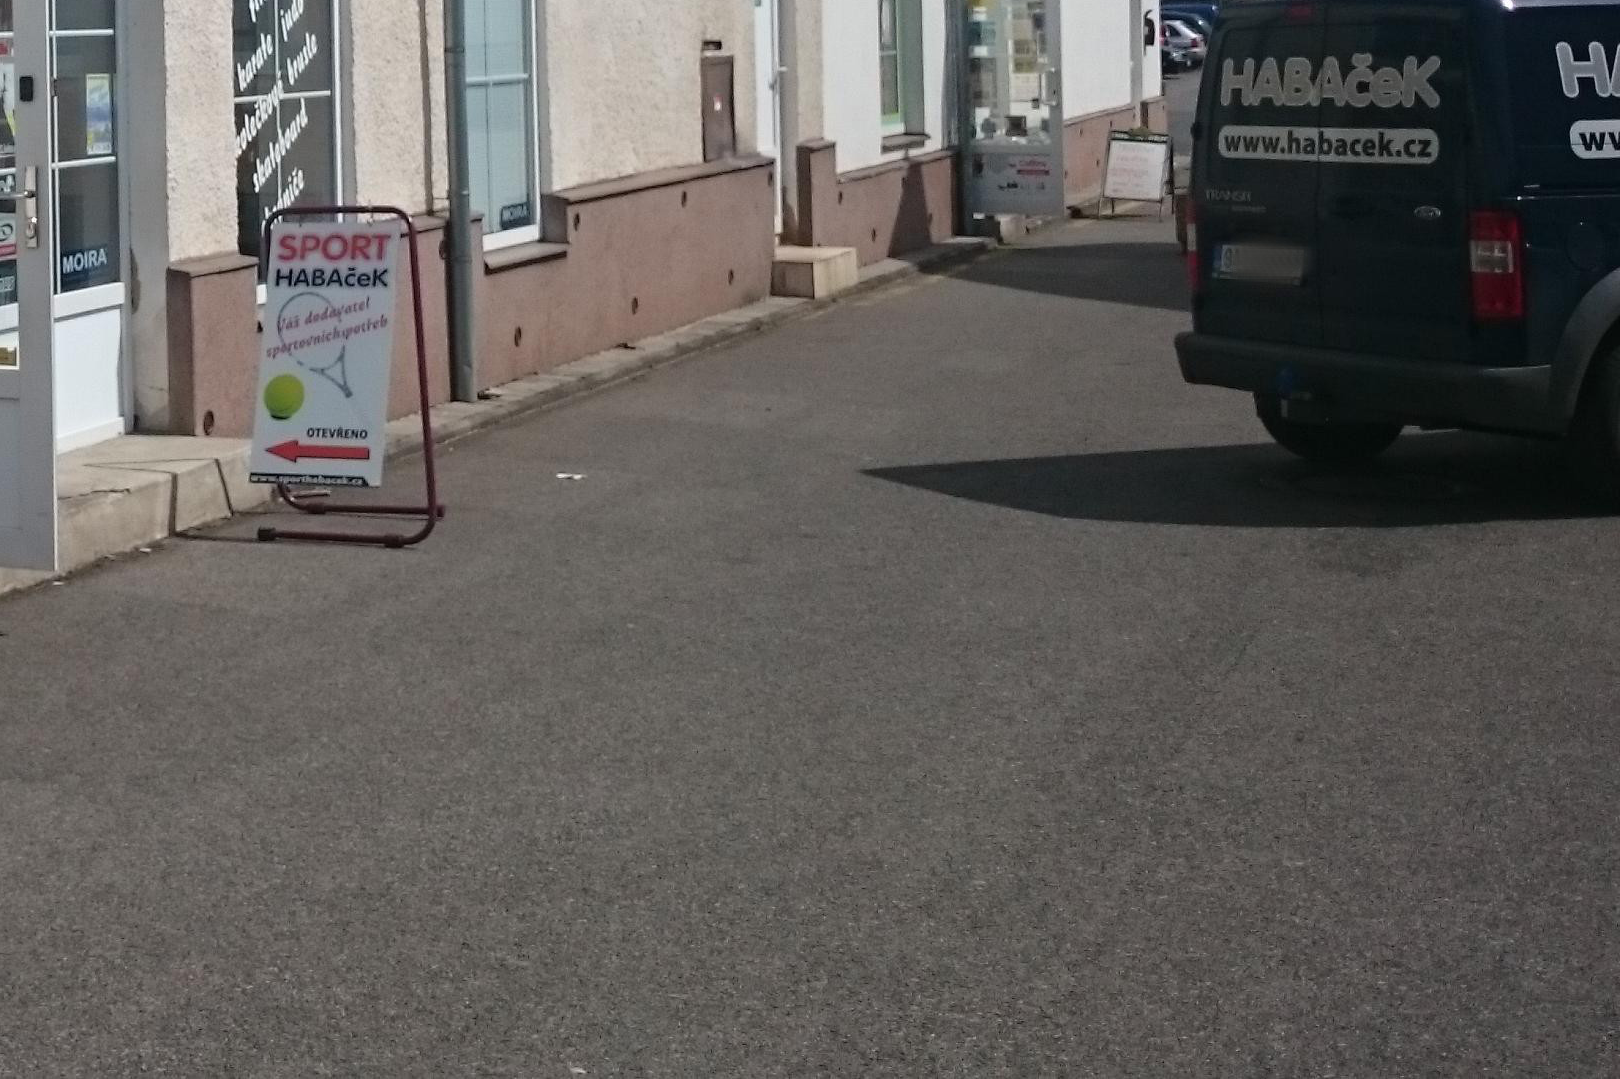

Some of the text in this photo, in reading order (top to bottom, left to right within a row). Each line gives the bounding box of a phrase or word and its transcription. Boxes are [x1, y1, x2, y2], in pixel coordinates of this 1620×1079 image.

[237, 32, 274, 92] karate
[287, 32, 319, 86] brusle
[1220, 52, 1441, 109] HABAčeK
[253, 97, 309, 193] skateboard
[1224, 131, 1432, 159] www.habacek.cz
[62, 248, 107, 274] MOIRA
[277, 234, 391, 262] SPORT
[275, 266, 388, 288] HABAčeK
[304, 296, 370, 325] dodavatel
[266, 314, 388, 359] sportovních potřeb
[306, 427, 368, 439] OTEVŘENO
